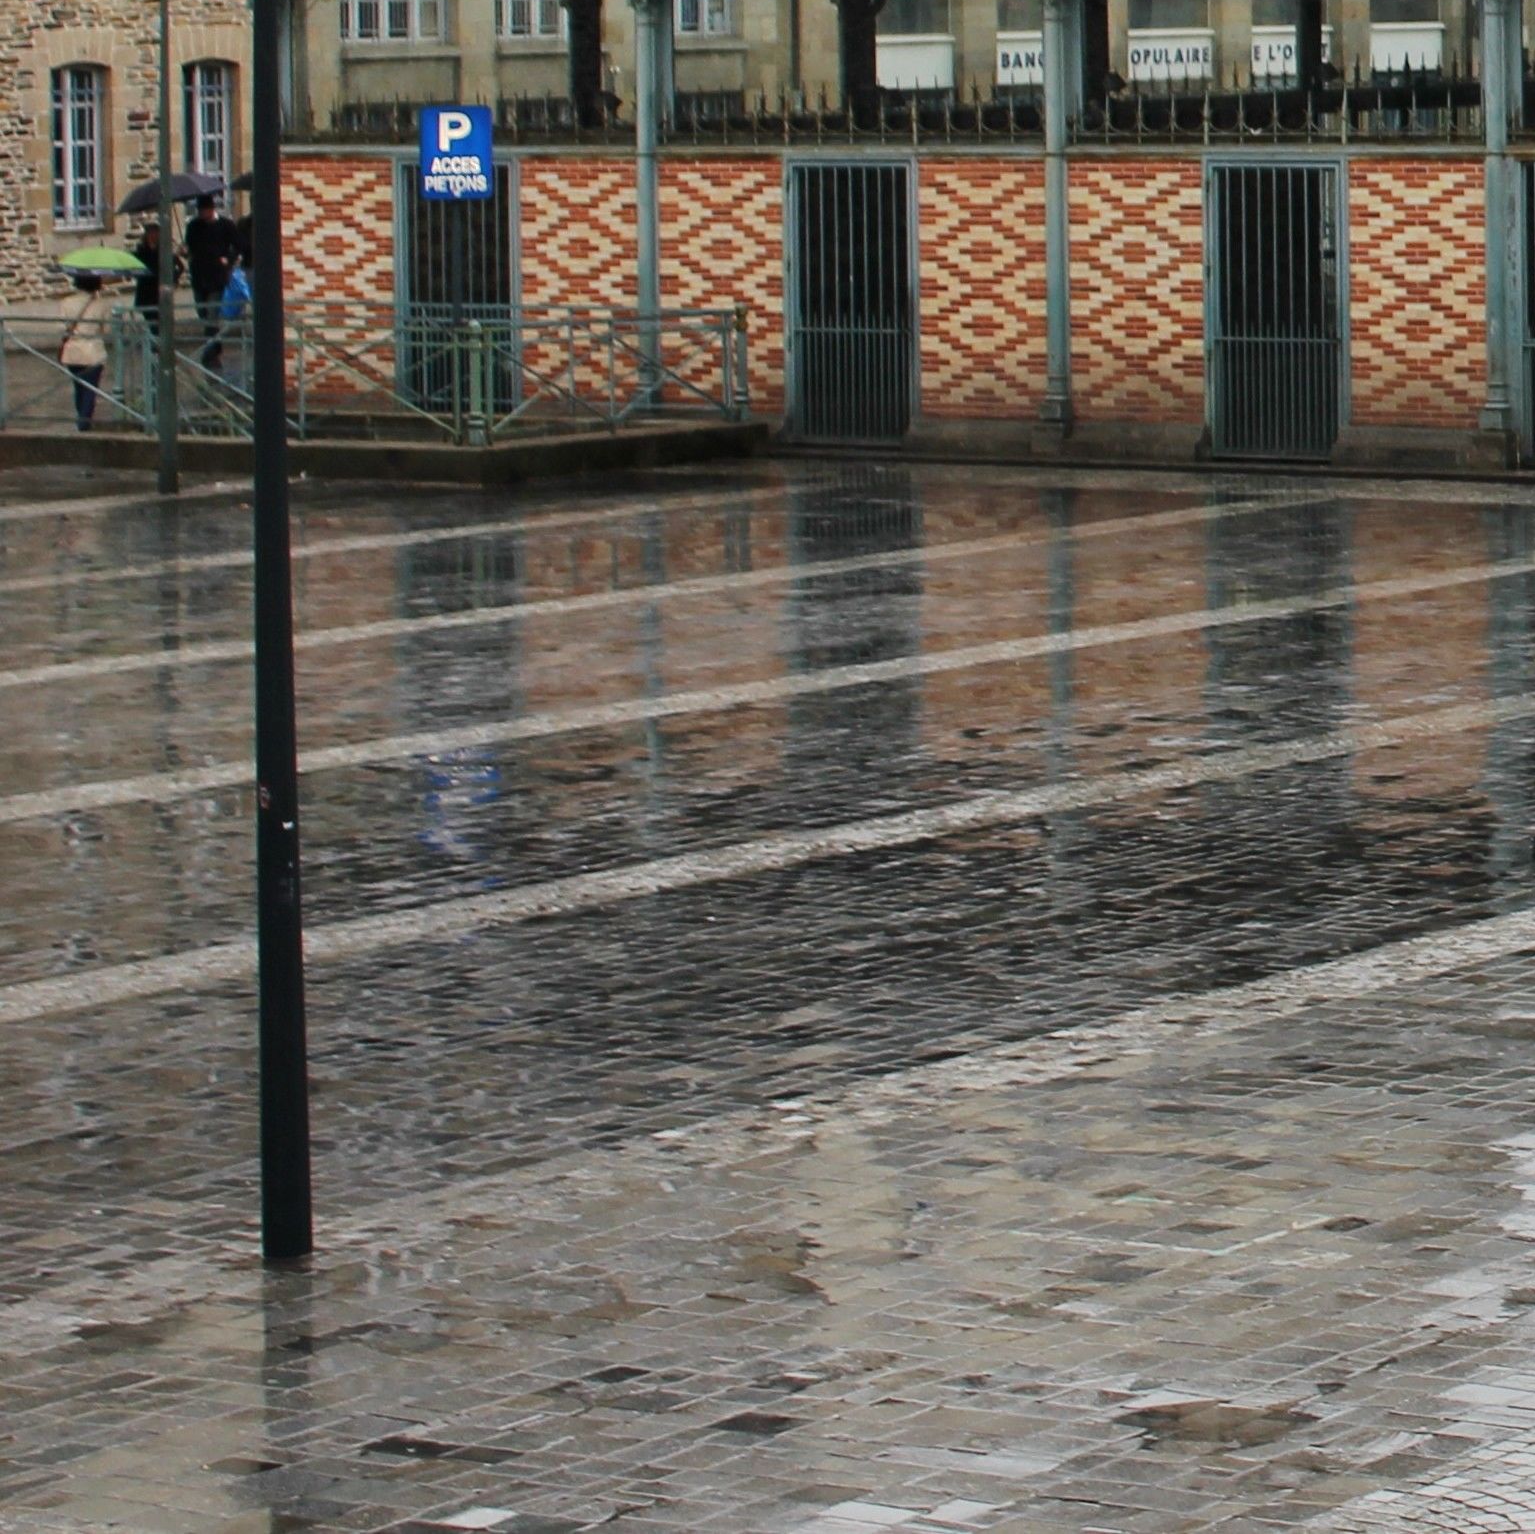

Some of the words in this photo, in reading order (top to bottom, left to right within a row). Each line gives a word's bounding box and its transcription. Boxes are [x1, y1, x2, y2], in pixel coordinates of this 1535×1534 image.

[438, 111, 473, 153] P
[431, 156, 482, 174] ACCES
[424, 174, 488, 192] PIETONS
